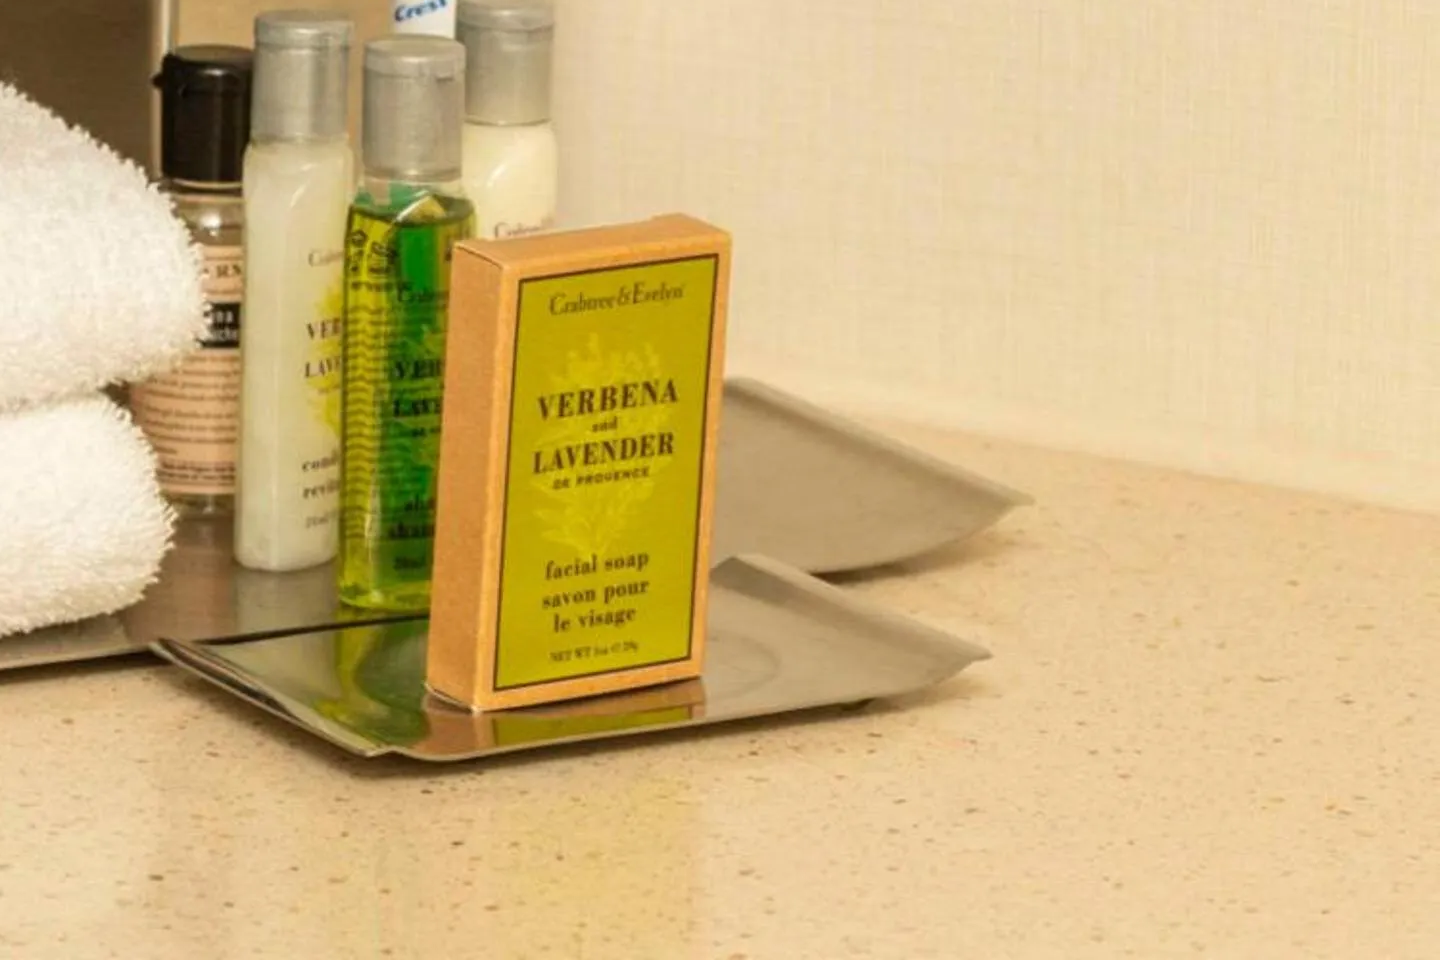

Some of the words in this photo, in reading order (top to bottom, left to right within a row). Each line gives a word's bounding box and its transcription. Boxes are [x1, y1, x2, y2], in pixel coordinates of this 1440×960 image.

[537, 378, 680, 422] VERBENA
[532, 431, 674, 475] LAVENDER
[545, 552, 597, 581] facial
[604, 552, 650, 572] soap
[542, 589, 596, 610] savon
[603, 580, 650, 605] pour
[553, 613, 571, 633] le
[578, 608, 637, 630] visage
